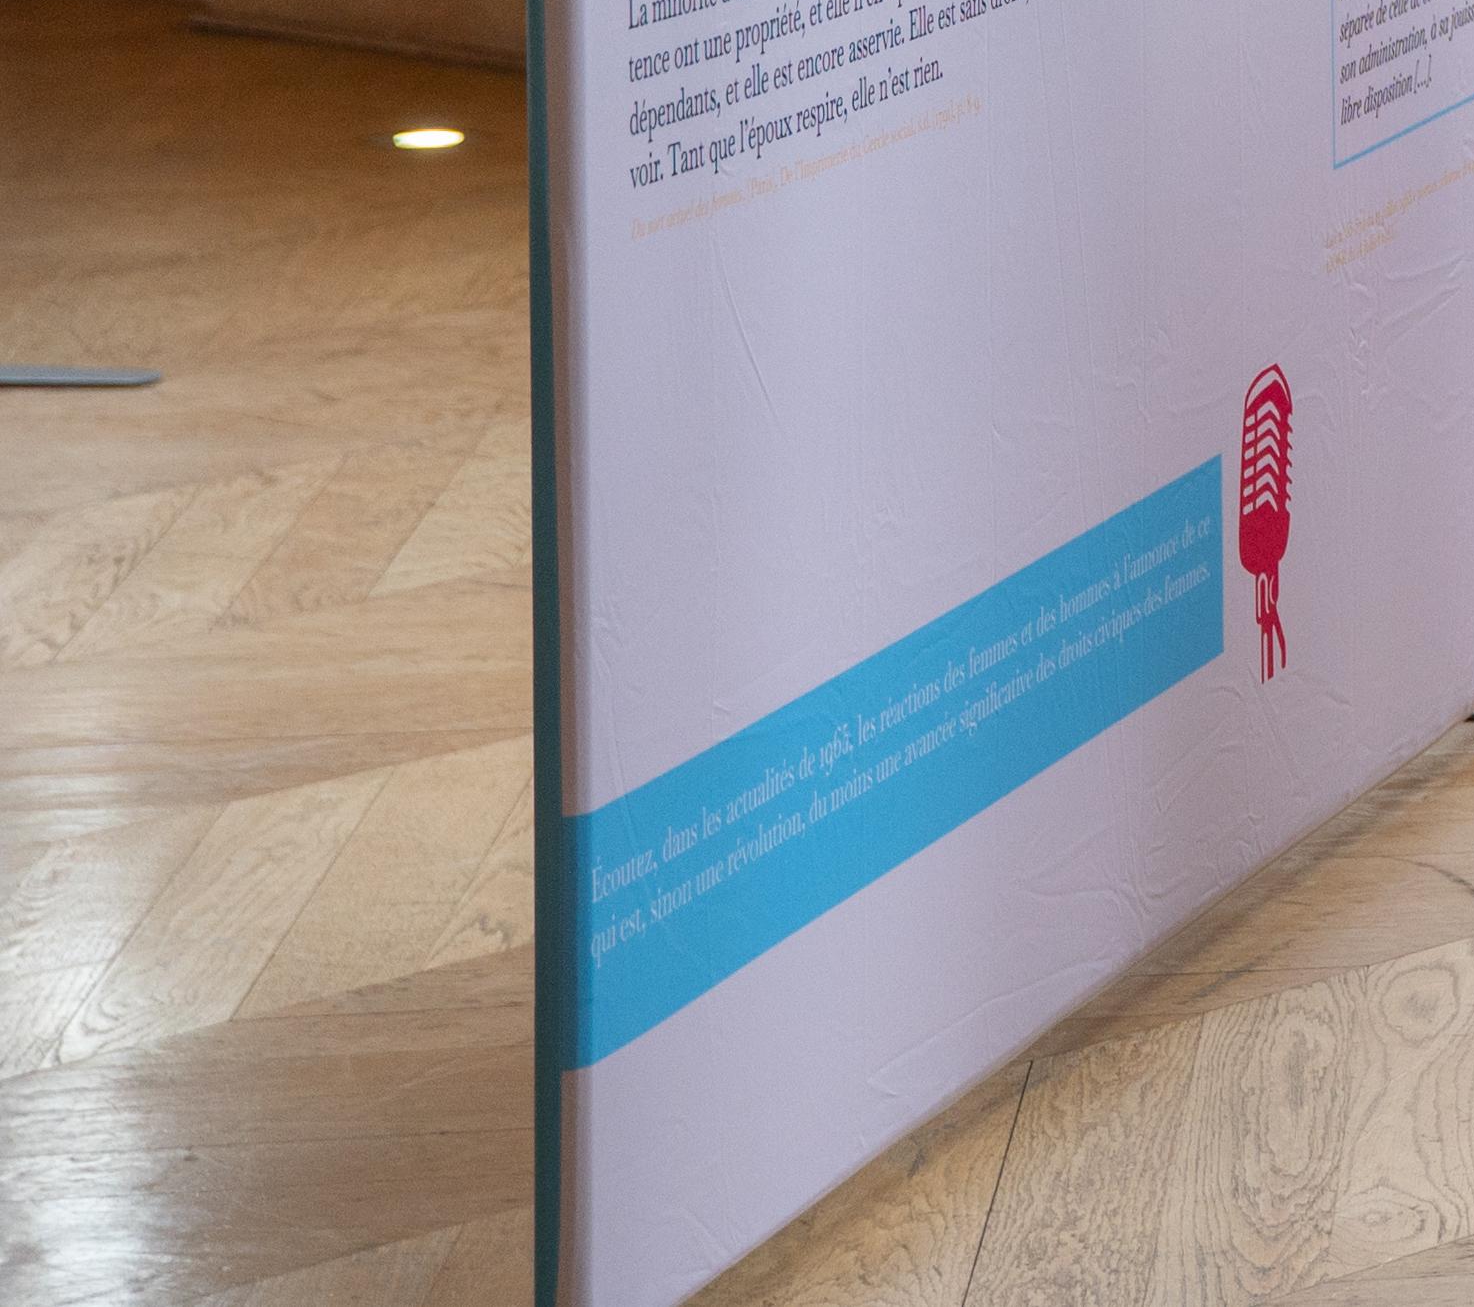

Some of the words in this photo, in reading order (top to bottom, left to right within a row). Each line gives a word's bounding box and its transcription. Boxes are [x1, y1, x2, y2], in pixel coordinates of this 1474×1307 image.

[629, 151, 664, 188] voir.
[666, 140, 705, 177] Tant
[708, 134, 735, 174] que
[795, 91, 848, 137] respire,
[851, 75, 875, 111] elle
[912, 56, 943, 89] rien.
[591, 856, 658, 903] Écoutez,
[662, 826, 698, 863] dans
[702, 807, 721, 839] les
[726, 759, 795, 825] actualités
[799, 747, 815, 780] de
[857, 714, 876, 745] les
[880, 678, 941, 732] réactions
[944, 661, 965, 693] des
[968, 633, 1018, 679] femmes
[1021, 619, 1033, 645] et
[1036, 607, 1056, 636] des
[1060, 578, 1110, 623] hommes
[1182, 519, 1195, 549] de
[1197, 516, 1210, 538] ce
